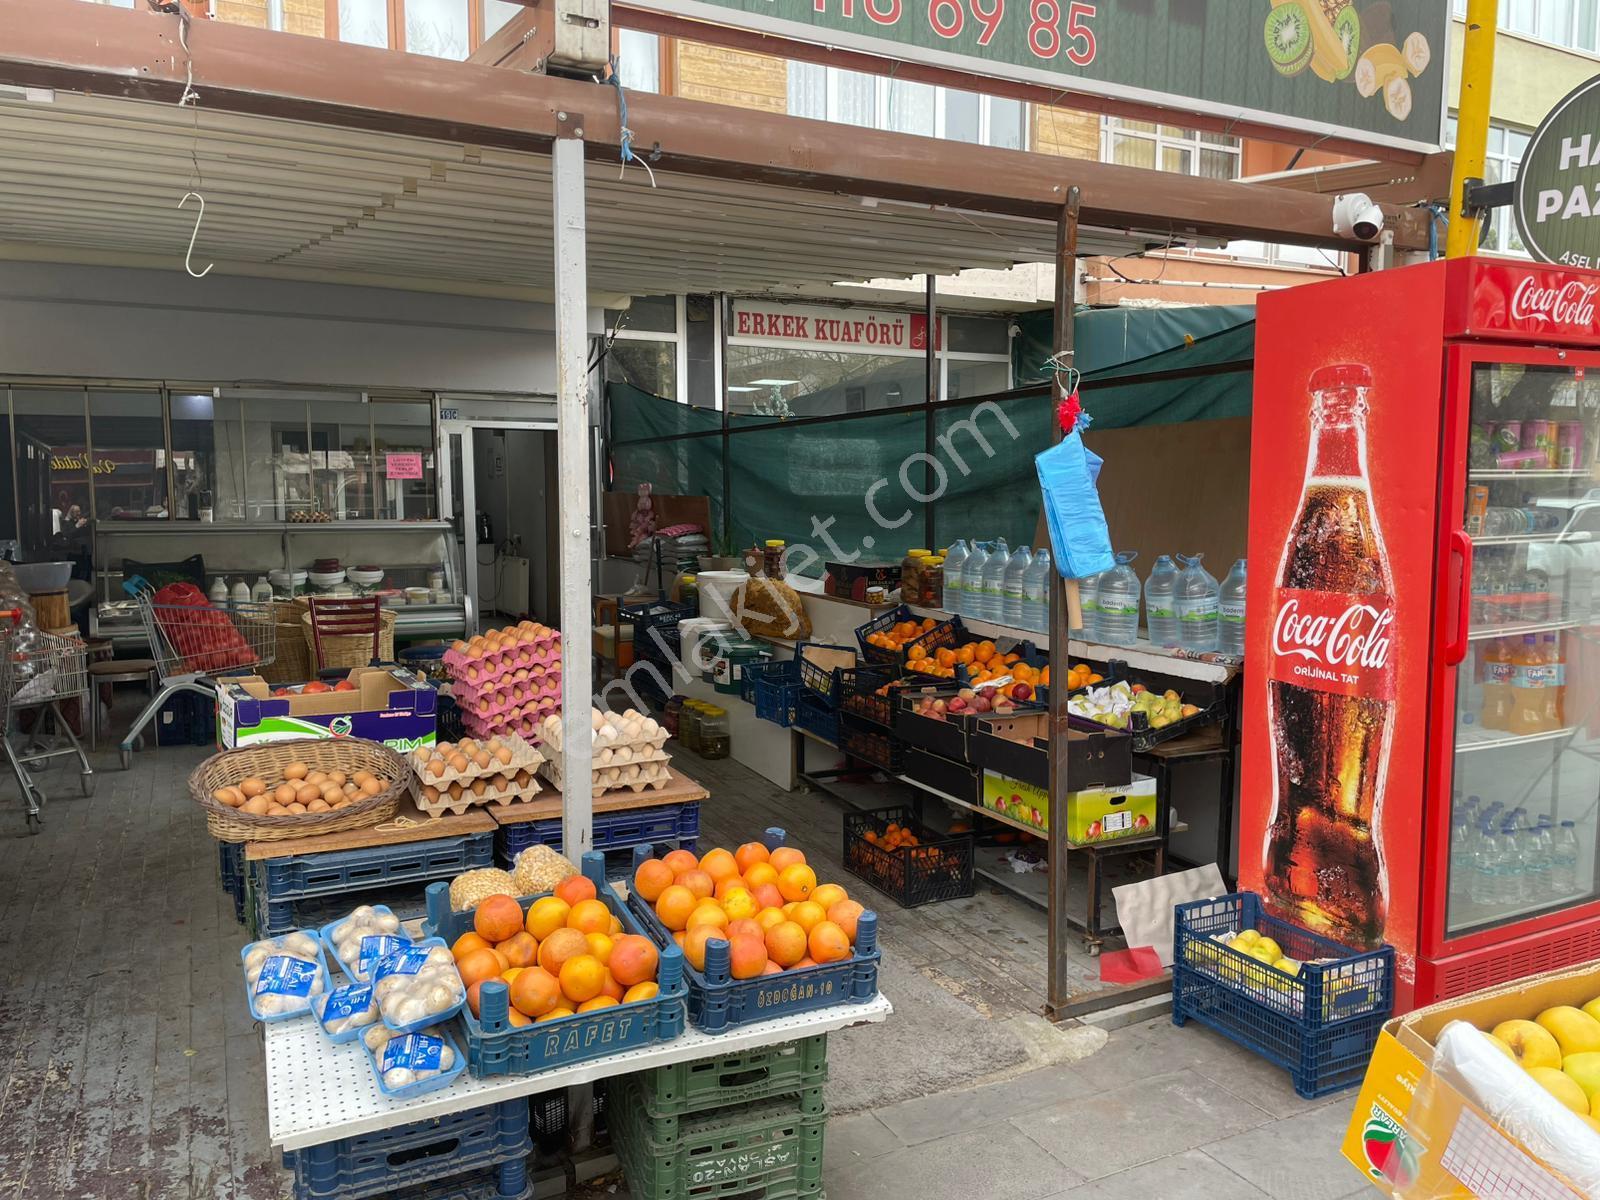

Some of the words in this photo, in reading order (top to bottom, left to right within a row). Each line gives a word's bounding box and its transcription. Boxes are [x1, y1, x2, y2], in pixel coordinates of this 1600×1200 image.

[927, 0, 1005, 46] 69
[1027, 0, 1097, 66] 85
[1559, 250, 1592, 270] ASEL
[1512, 276, 1598, 325] Coca-Cola
[738, 312, 809, 339] ERKEK
[815, 316, 905, 346] KUAFÖRÜ
[1272, 599, 1394, 669] Coca-Cola
[1341, 673, 1360, 685] TAT
[544, 1018, 632, 1057] RAFET
